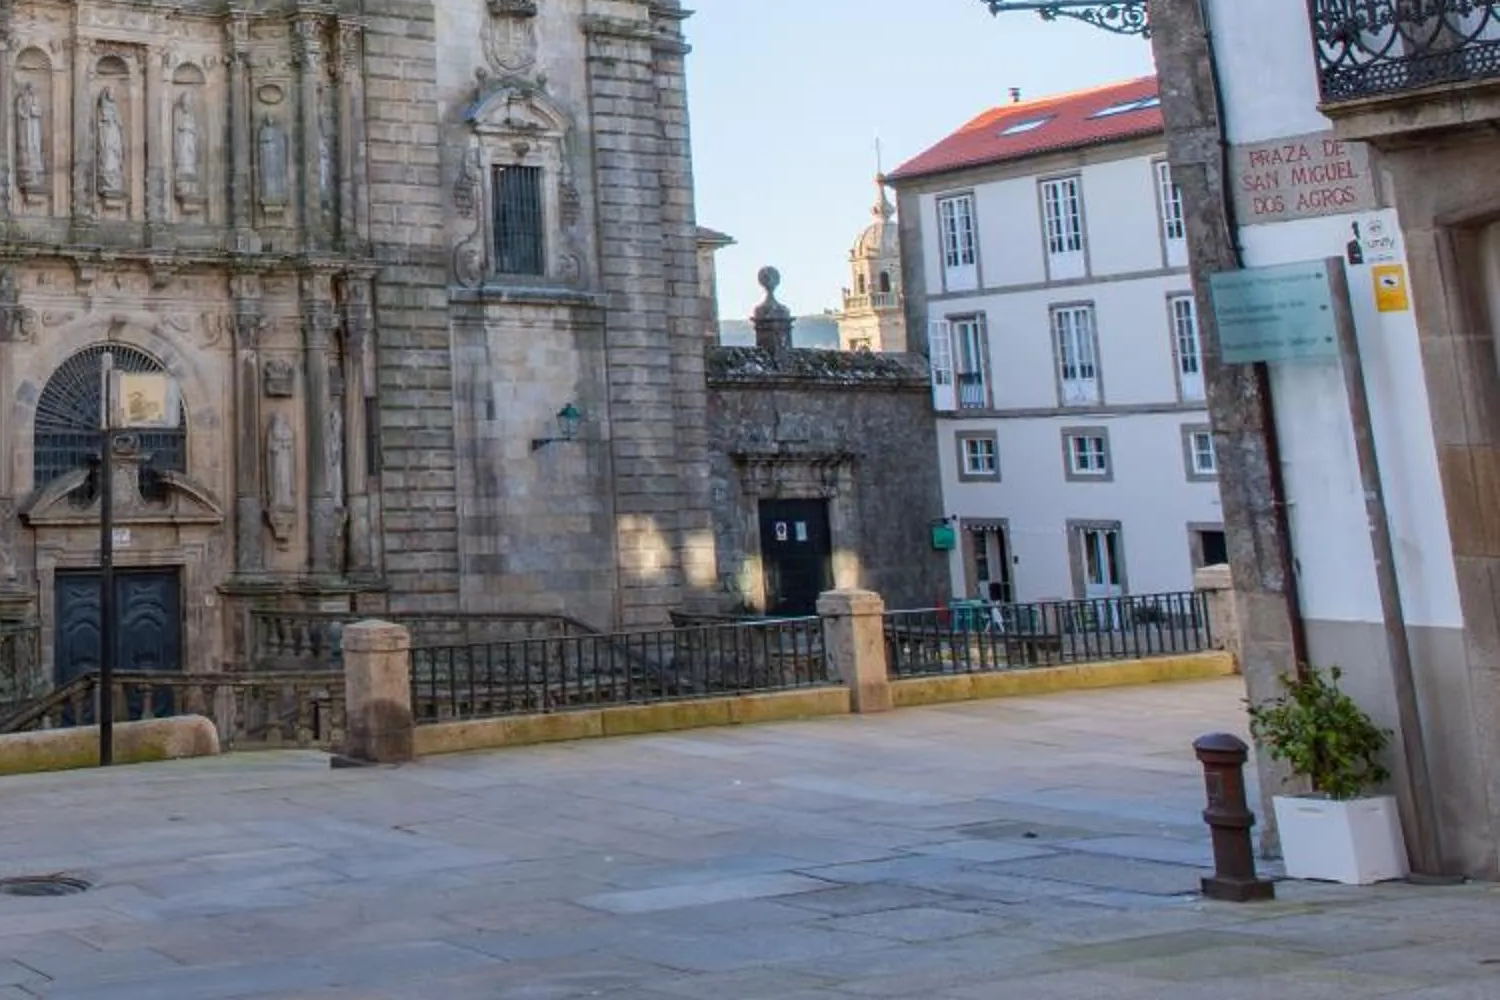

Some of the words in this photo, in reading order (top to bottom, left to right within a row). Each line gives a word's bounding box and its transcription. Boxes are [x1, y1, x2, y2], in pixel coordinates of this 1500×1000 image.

[1249, 144, 1311, 168] PRAZA
[1322, 139, 1346, 157] DE
[1243, 170, 1279, 191] SAN
[1291, 160, 1358, 186] MIGUEL
[1253, 195, 1284, 214] DOS
[1297, 186, 1355, 210] AGROS
